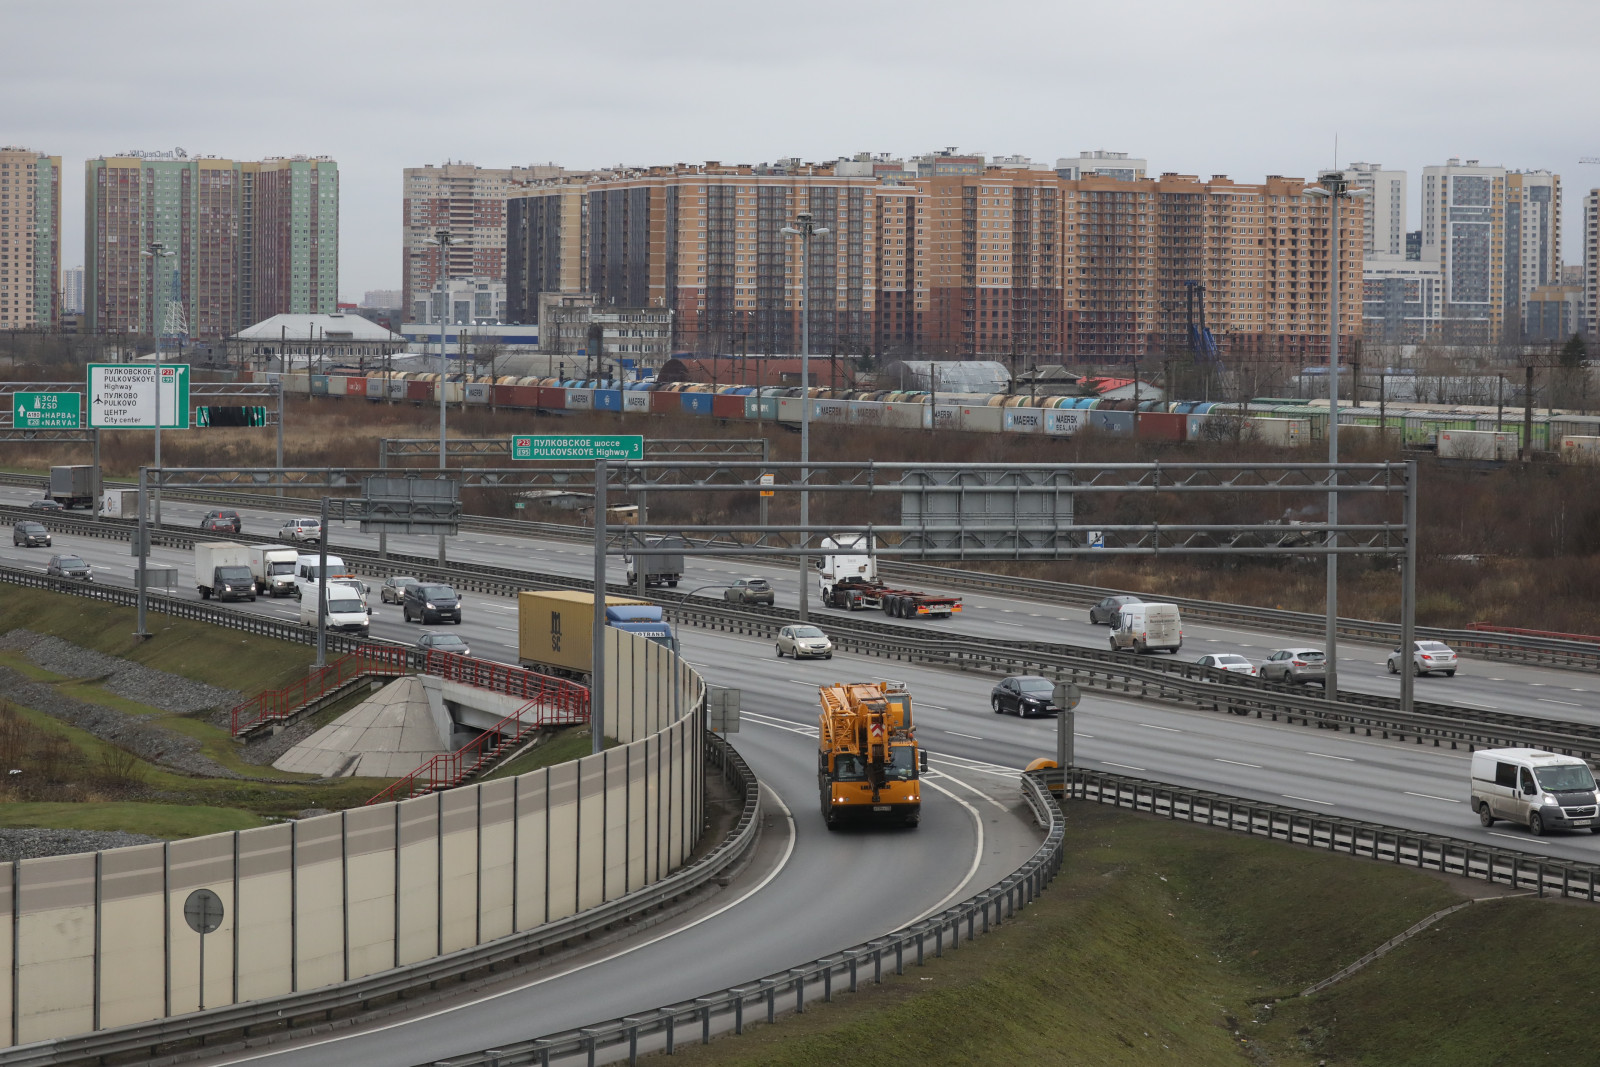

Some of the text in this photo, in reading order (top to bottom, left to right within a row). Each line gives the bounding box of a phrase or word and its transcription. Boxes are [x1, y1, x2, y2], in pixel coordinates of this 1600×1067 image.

[1014, 416, 1038, 426] MAERSK
[1056, 415, 1078, 424] MAERSK
[596, 448, 629, 458] Highway
